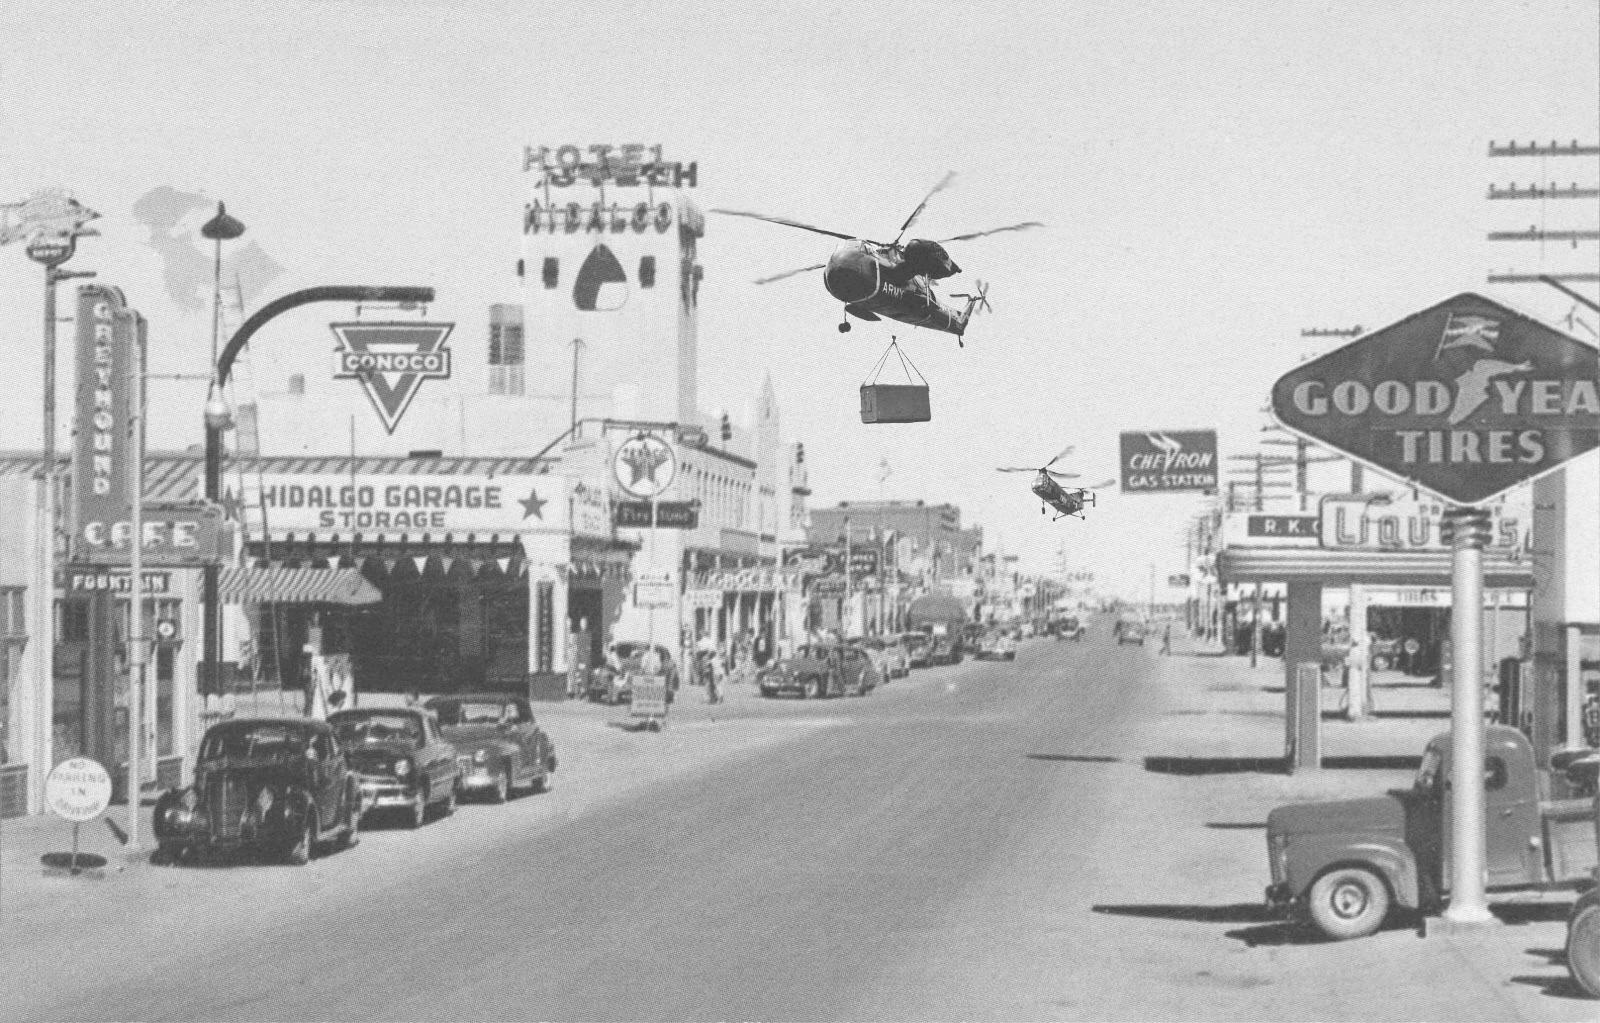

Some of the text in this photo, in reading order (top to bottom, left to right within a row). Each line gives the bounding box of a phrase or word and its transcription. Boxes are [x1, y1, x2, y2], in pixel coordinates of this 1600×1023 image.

[882, 281, 905, 299] ARMY
[346, 355, 439, 370] CONOCO
[93, 301, 113, 495] GREYHOUND
[1396, 430, 1544, 463] TIRES
[1130, 449, 1213, 471] CHEVRON
[1129, 473, 1215, 487] GAS STATION
[262, 485, 501, 508] HIDALGO GARAGE
[319, 511, 446, 528] STORAGE
[622, 507, 689, 522] Firetone
[1336, 506, 1518, 547] LIQUS
[73, 574, 165, 590] FOUNTIN
